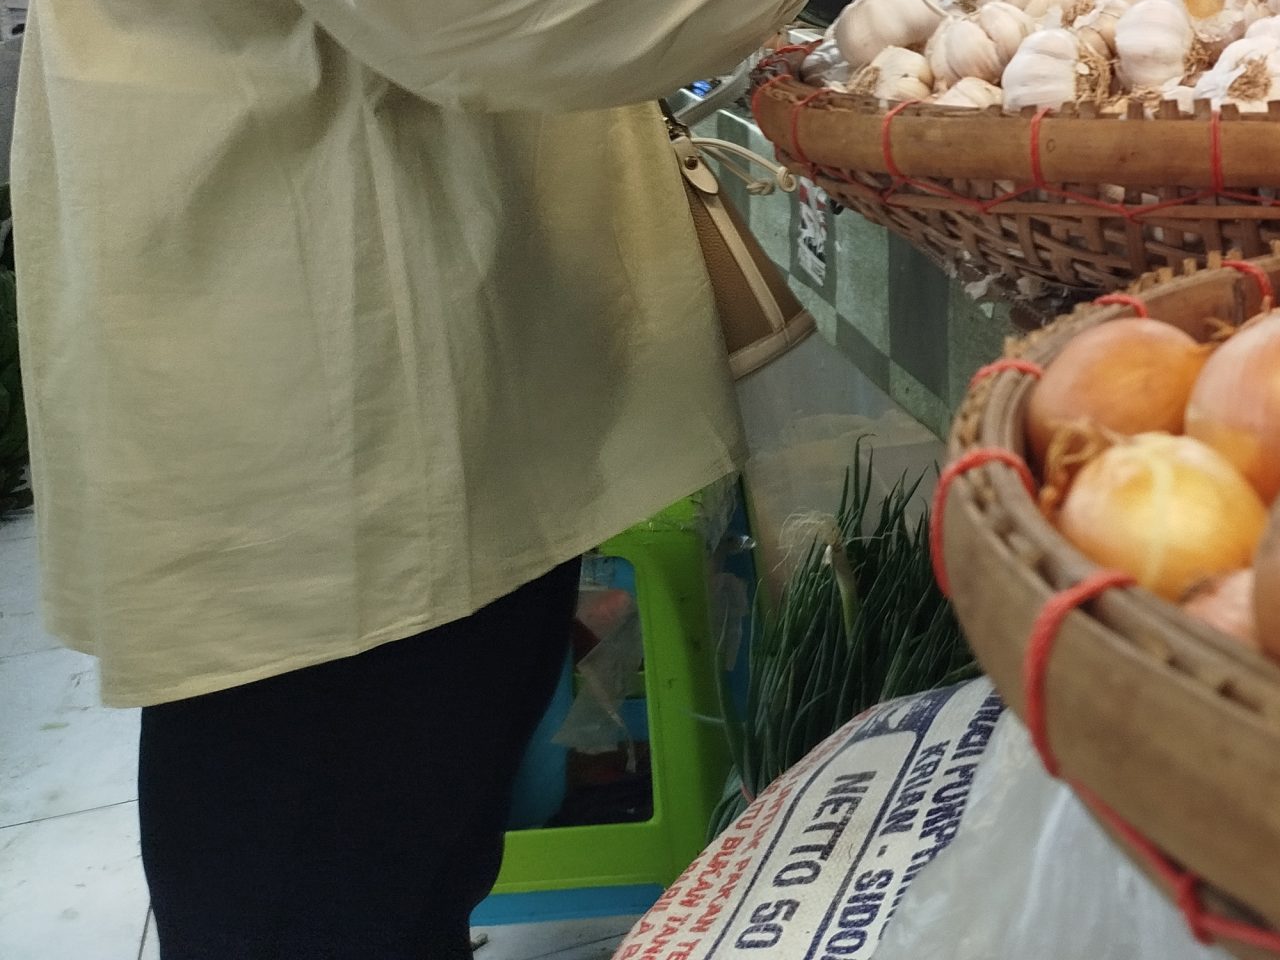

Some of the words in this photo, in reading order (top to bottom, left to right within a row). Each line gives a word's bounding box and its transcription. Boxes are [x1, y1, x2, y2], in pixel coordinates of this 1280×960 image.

[772, 770, 878, 887] NETTO
[878, 739, 951, 837] KRIAN
[678, 836, 746, 908] BUKAN
[688, 855, 753, 933] PAKAN
[734, 898, 801, 950] 50
[820, 869, 895, 960] SIDO
